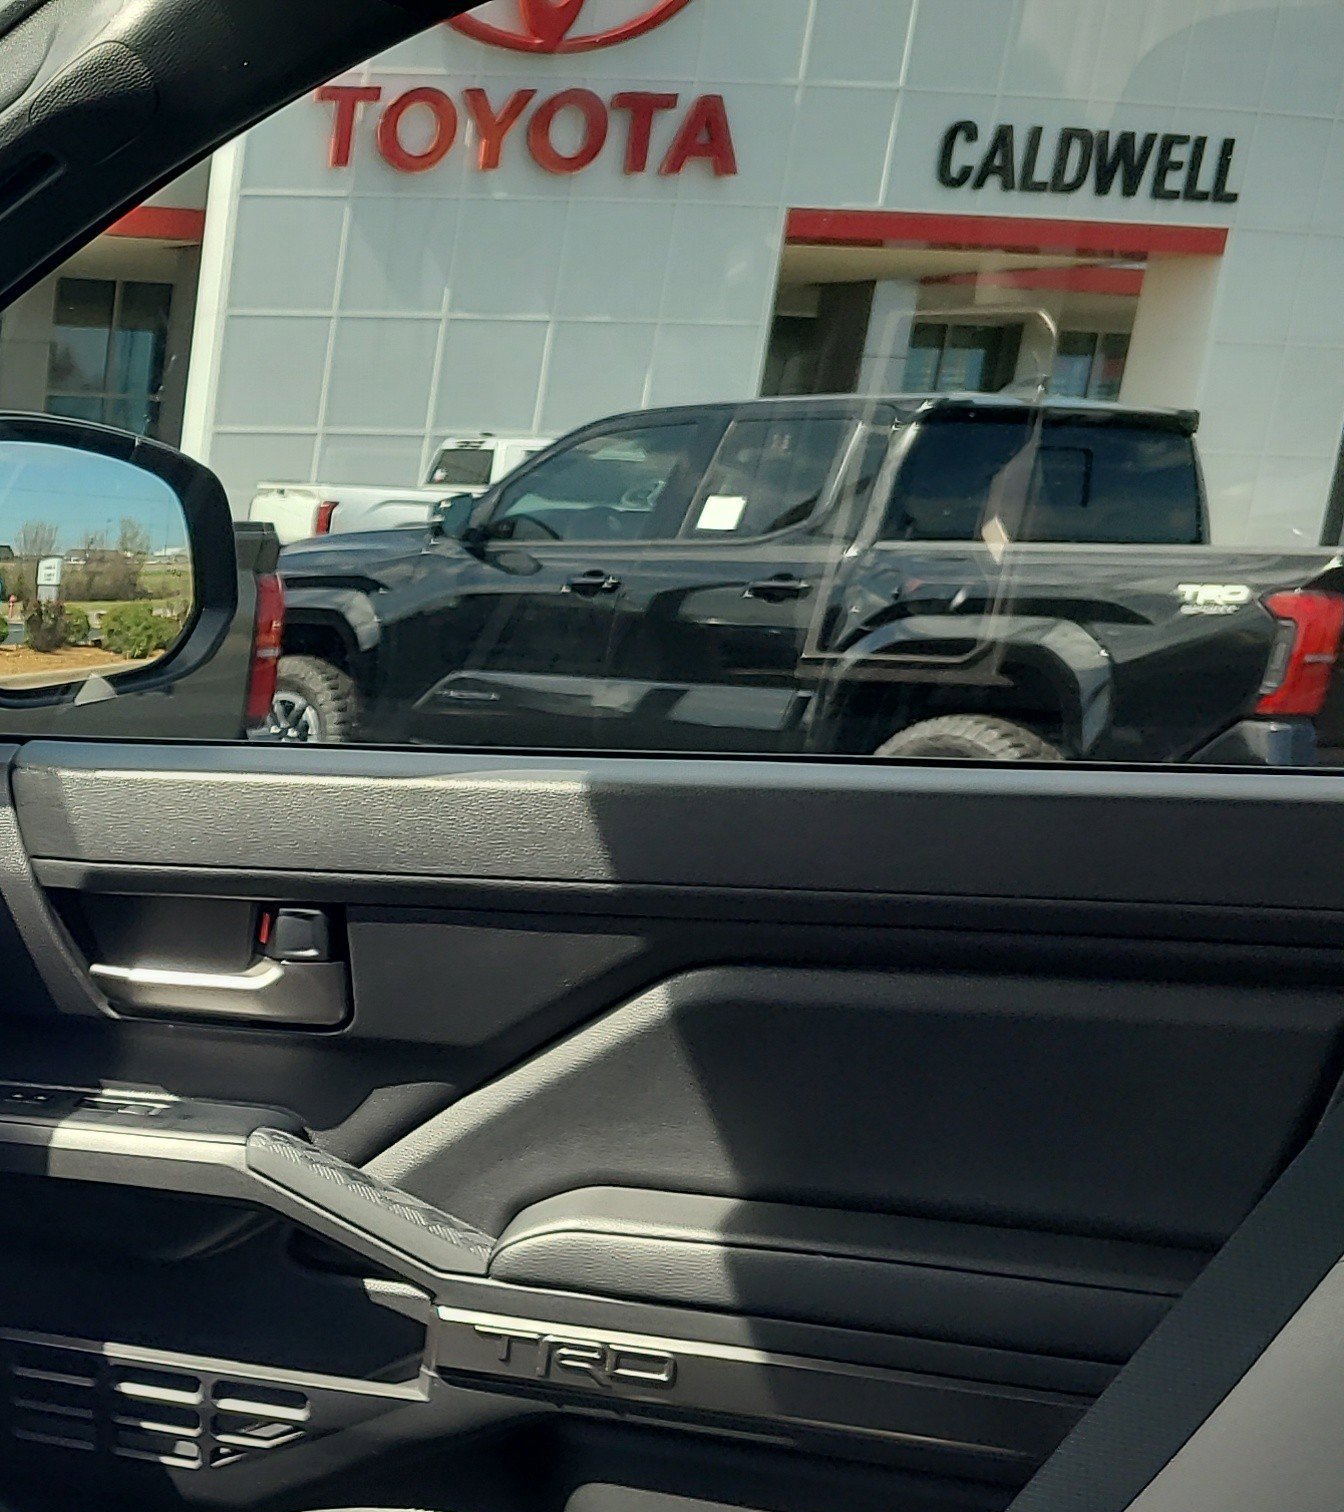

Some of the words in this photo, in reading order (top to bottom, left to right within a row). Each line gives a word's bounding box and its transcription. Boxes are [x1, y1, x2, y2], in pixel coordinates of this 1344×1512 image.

[315, 85, 738, 175] TOYOTA
[936, 120, 1240, 203] CALDWELL
[1177, 583, 1251, 605] TRD
[474, 1325, 678, 1389] TRD
